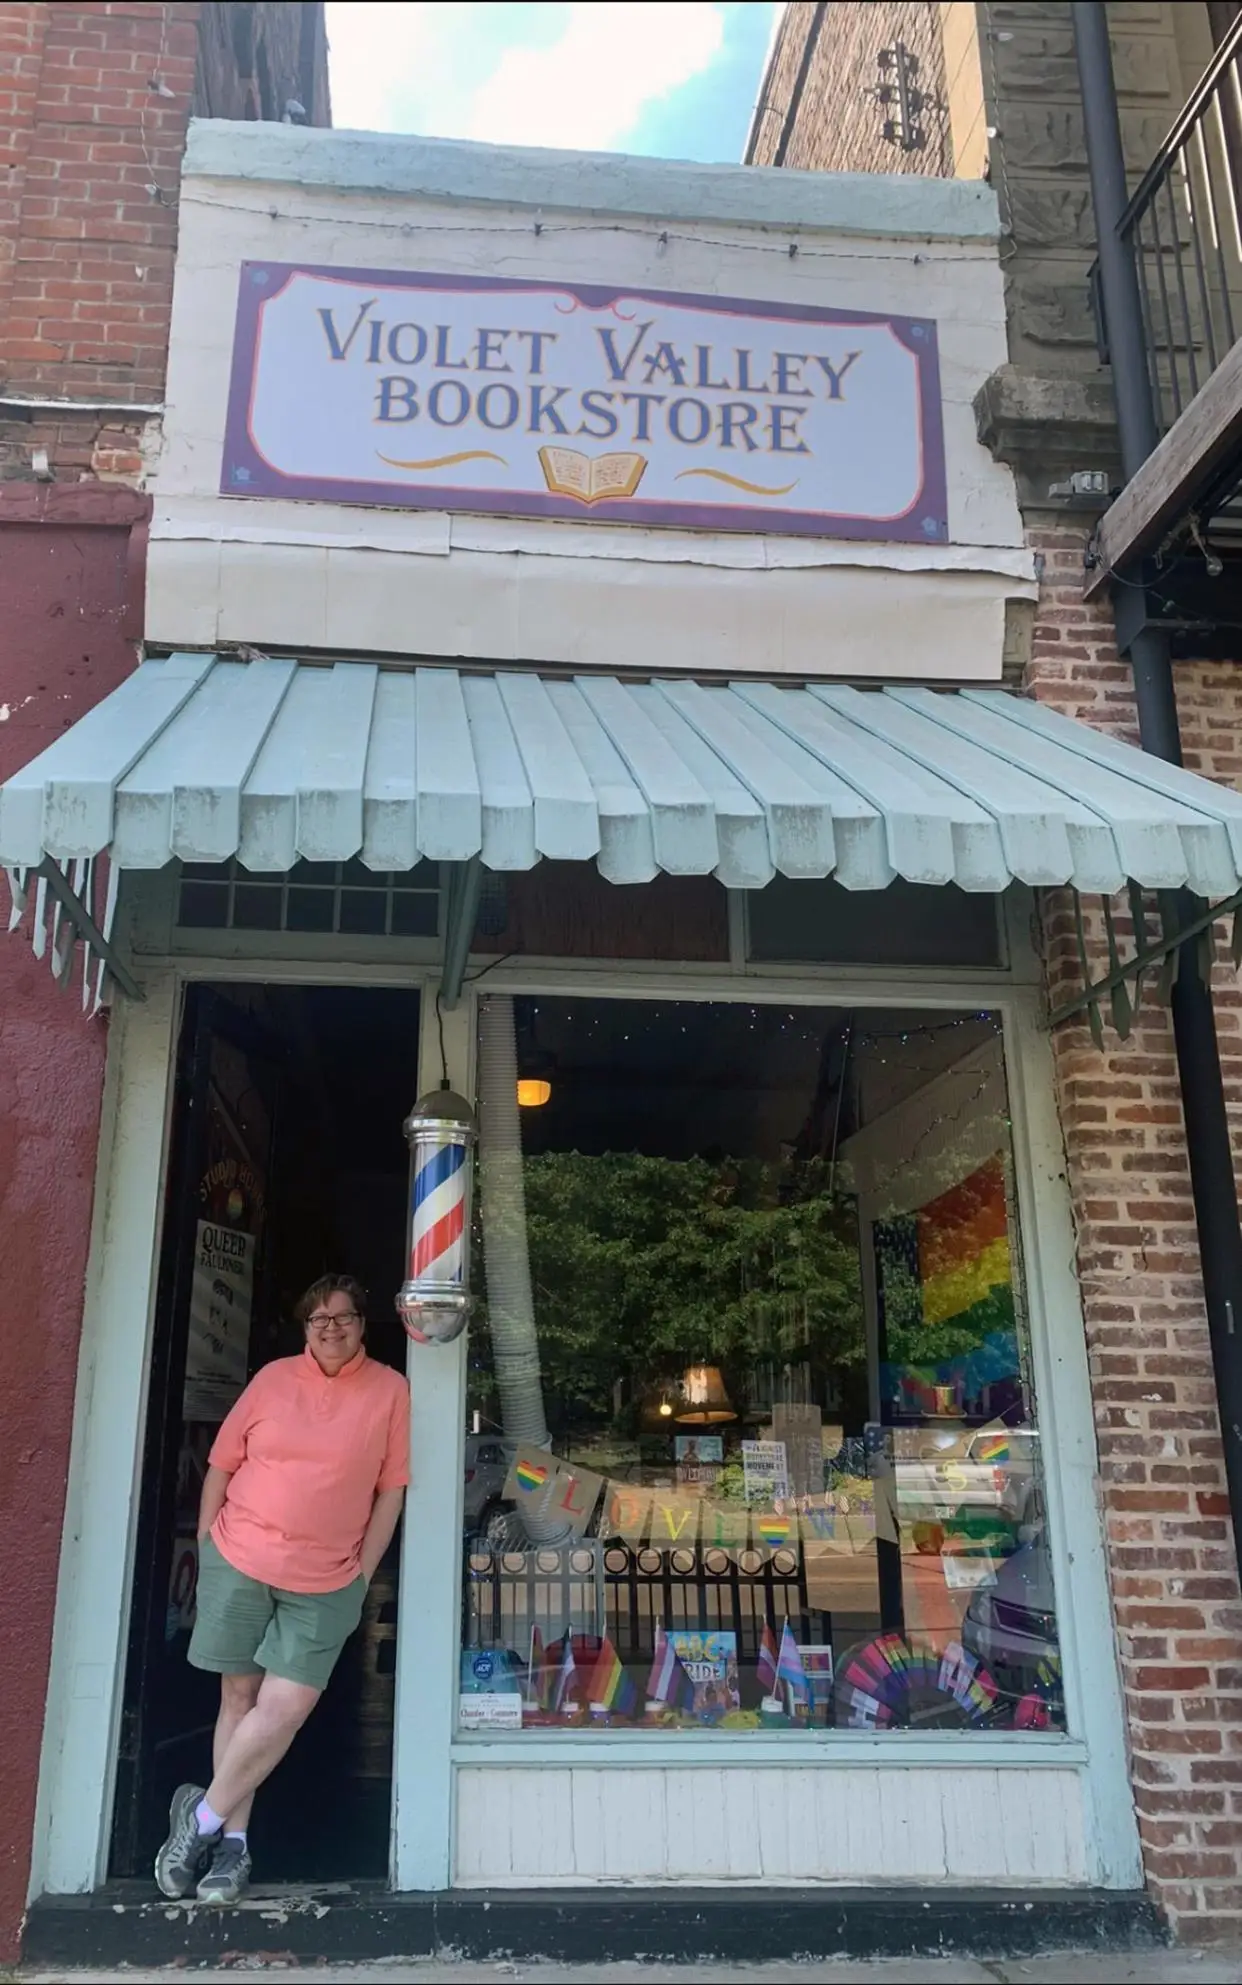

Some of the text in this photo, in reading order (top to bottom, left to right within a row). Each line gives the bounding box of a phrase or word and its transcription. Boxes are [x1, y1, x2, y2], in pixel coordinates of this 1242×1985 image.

[317, 298, 861, 400] VIOLET VALLEY
[374, 375, 812, 454] BOOKSTORE
[202, 1226, 246, 1258] QUEER
[684, 1663, 720, 1680] RIDE
